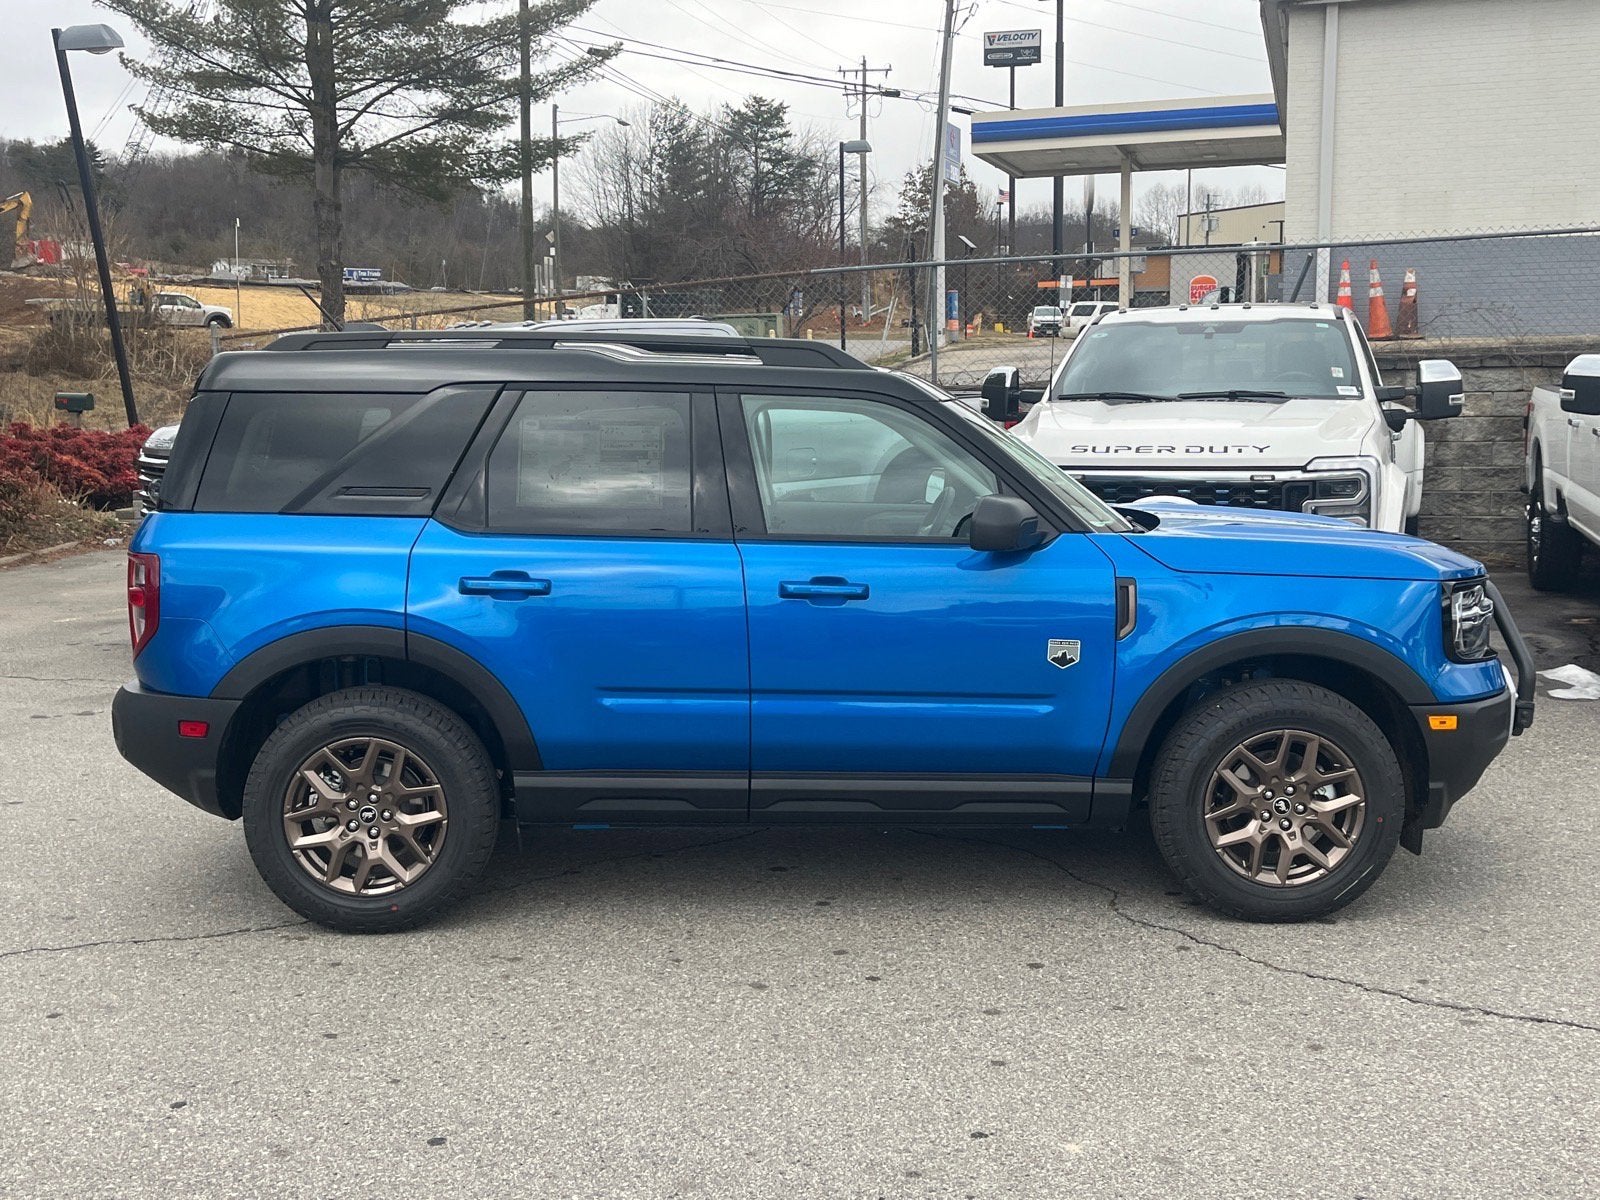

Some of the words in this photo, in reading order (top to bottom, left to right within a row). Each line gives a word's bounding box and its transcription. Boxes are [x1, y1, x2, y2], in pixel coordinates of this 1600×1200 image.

[997, 32, 1038, 42] VELOCITY
[1191, 284, 1217, 292] BURGER
[1070, 445, 1176, 454] SUPER
[1185, 445, 1271, 454] DUTY
